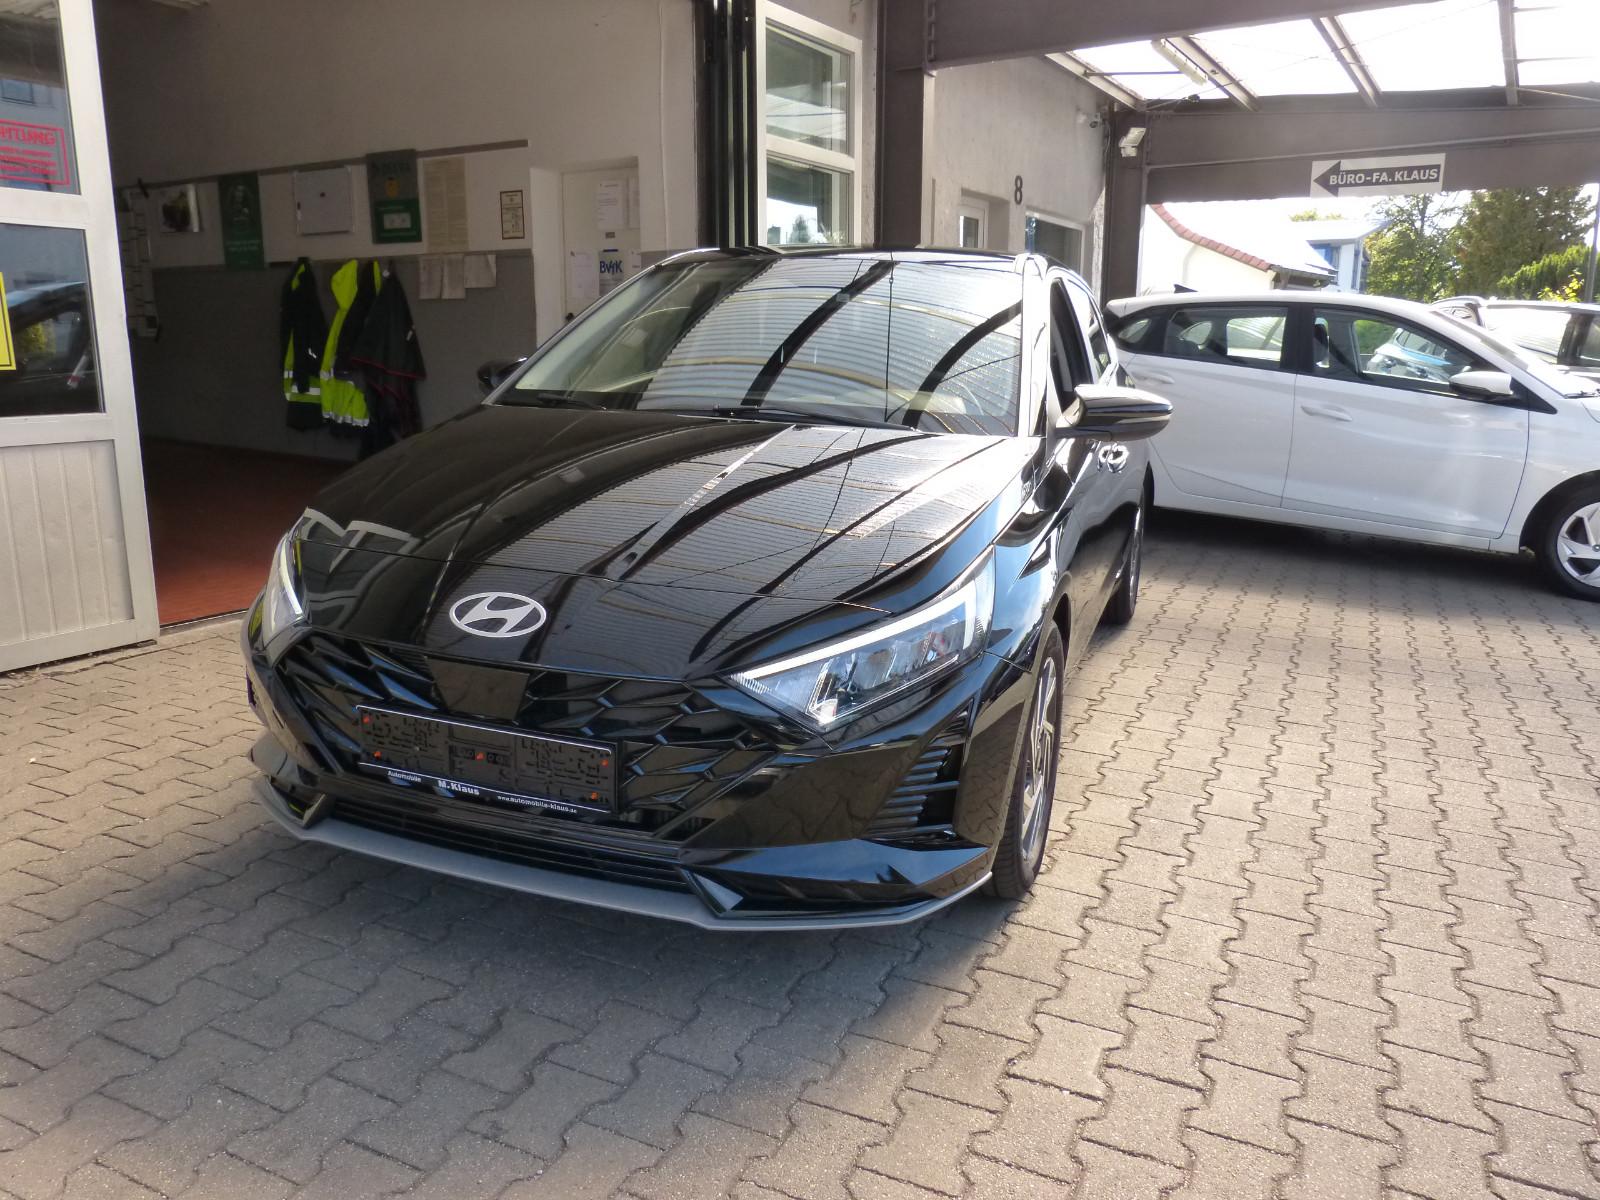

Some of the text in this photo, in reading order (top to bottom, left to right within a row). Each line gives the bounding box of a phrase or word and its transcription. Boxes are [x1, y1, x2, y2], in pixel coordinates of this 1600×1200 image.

[1394, 168, 1438, 182] KLAUS
[1014, 175, 1023, 205] 8
[387, 771, 421, 782] Automobile
